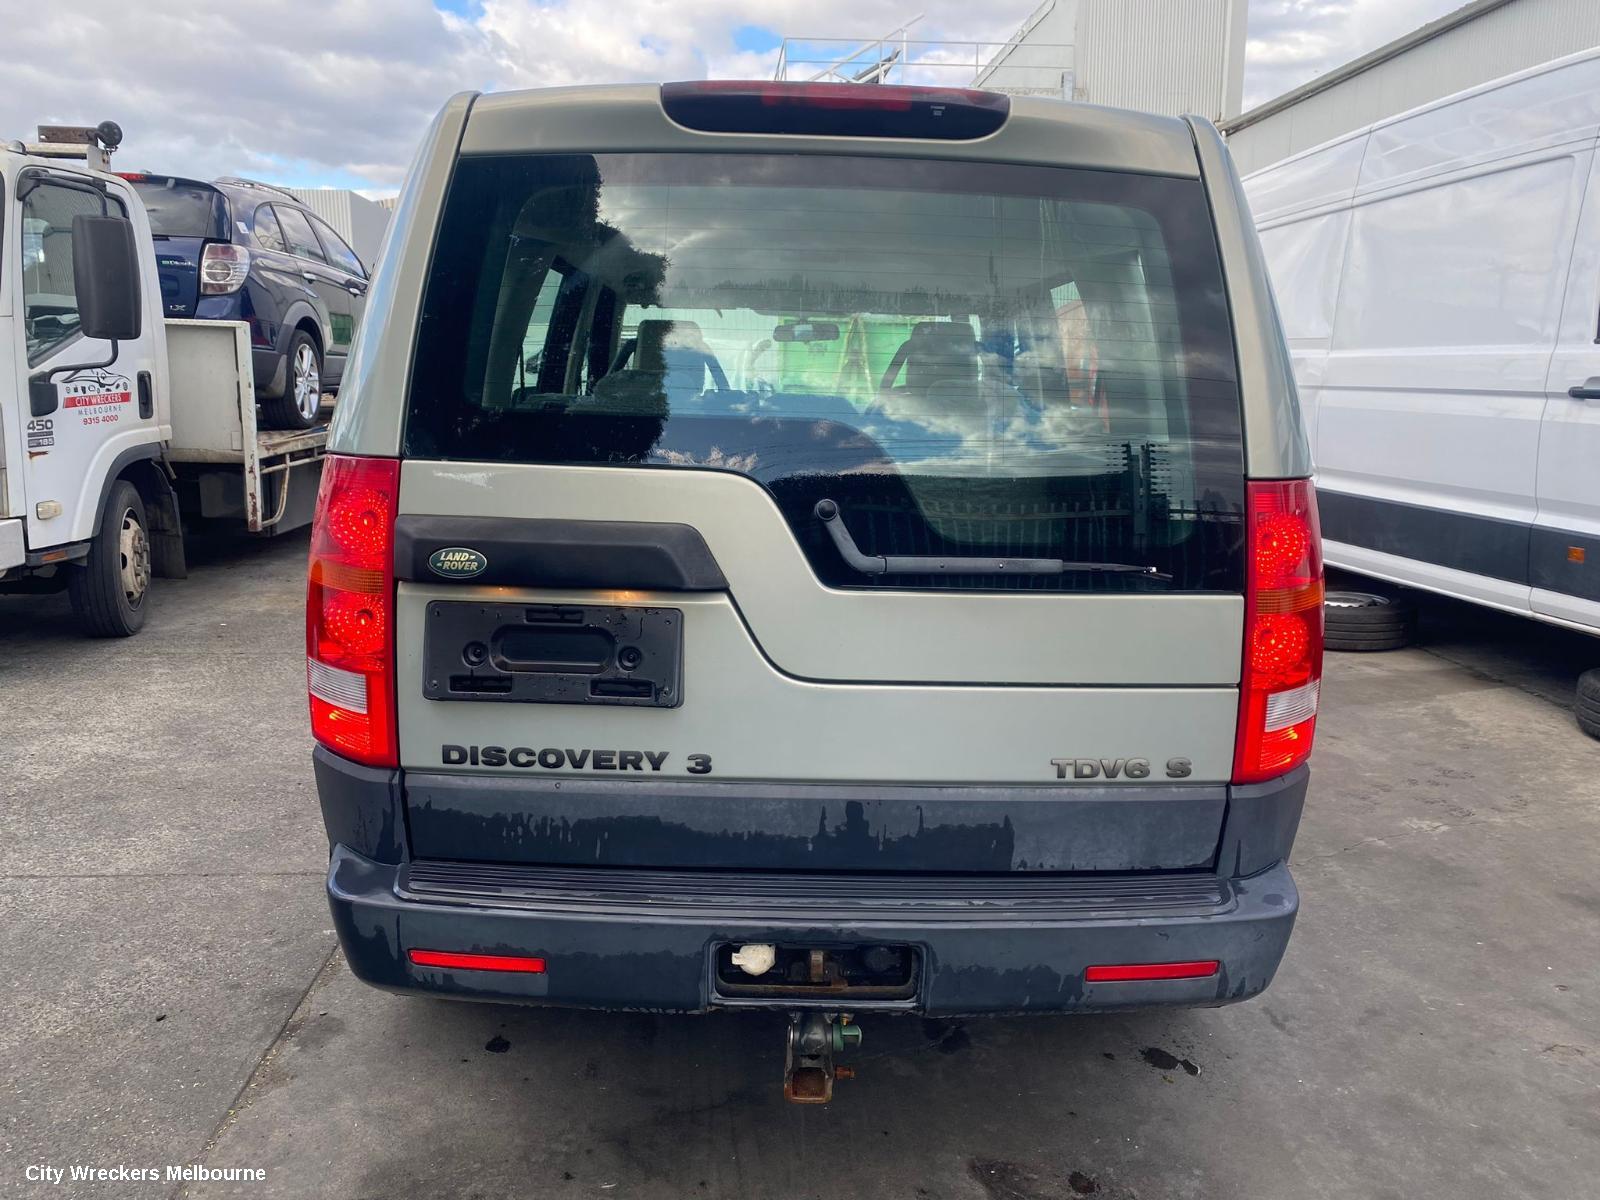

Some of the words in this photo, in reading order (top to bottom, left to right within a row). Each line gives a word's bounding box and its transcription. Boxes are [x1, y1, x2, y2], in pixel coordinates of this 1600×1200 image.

[75, 396, 90, 406] CITY
[90, 393, 122, 405] WRECKERS
[78, 404, 122, 415] MELBOURNE
[27, 419, 54, 431] 450
[83, 416, 100, 425] 9315
[101, 414, 119, 423] 4000
[440, 552, 469, 561] LAND
[442, 561, 478, 570] ROVER
[441, 744, 670, 771] DISCOVERY
[686, 753, 713, 774] 3
[1050, 757, 1151, 779] TDV6
[1165, 757, 1193, 778] S
